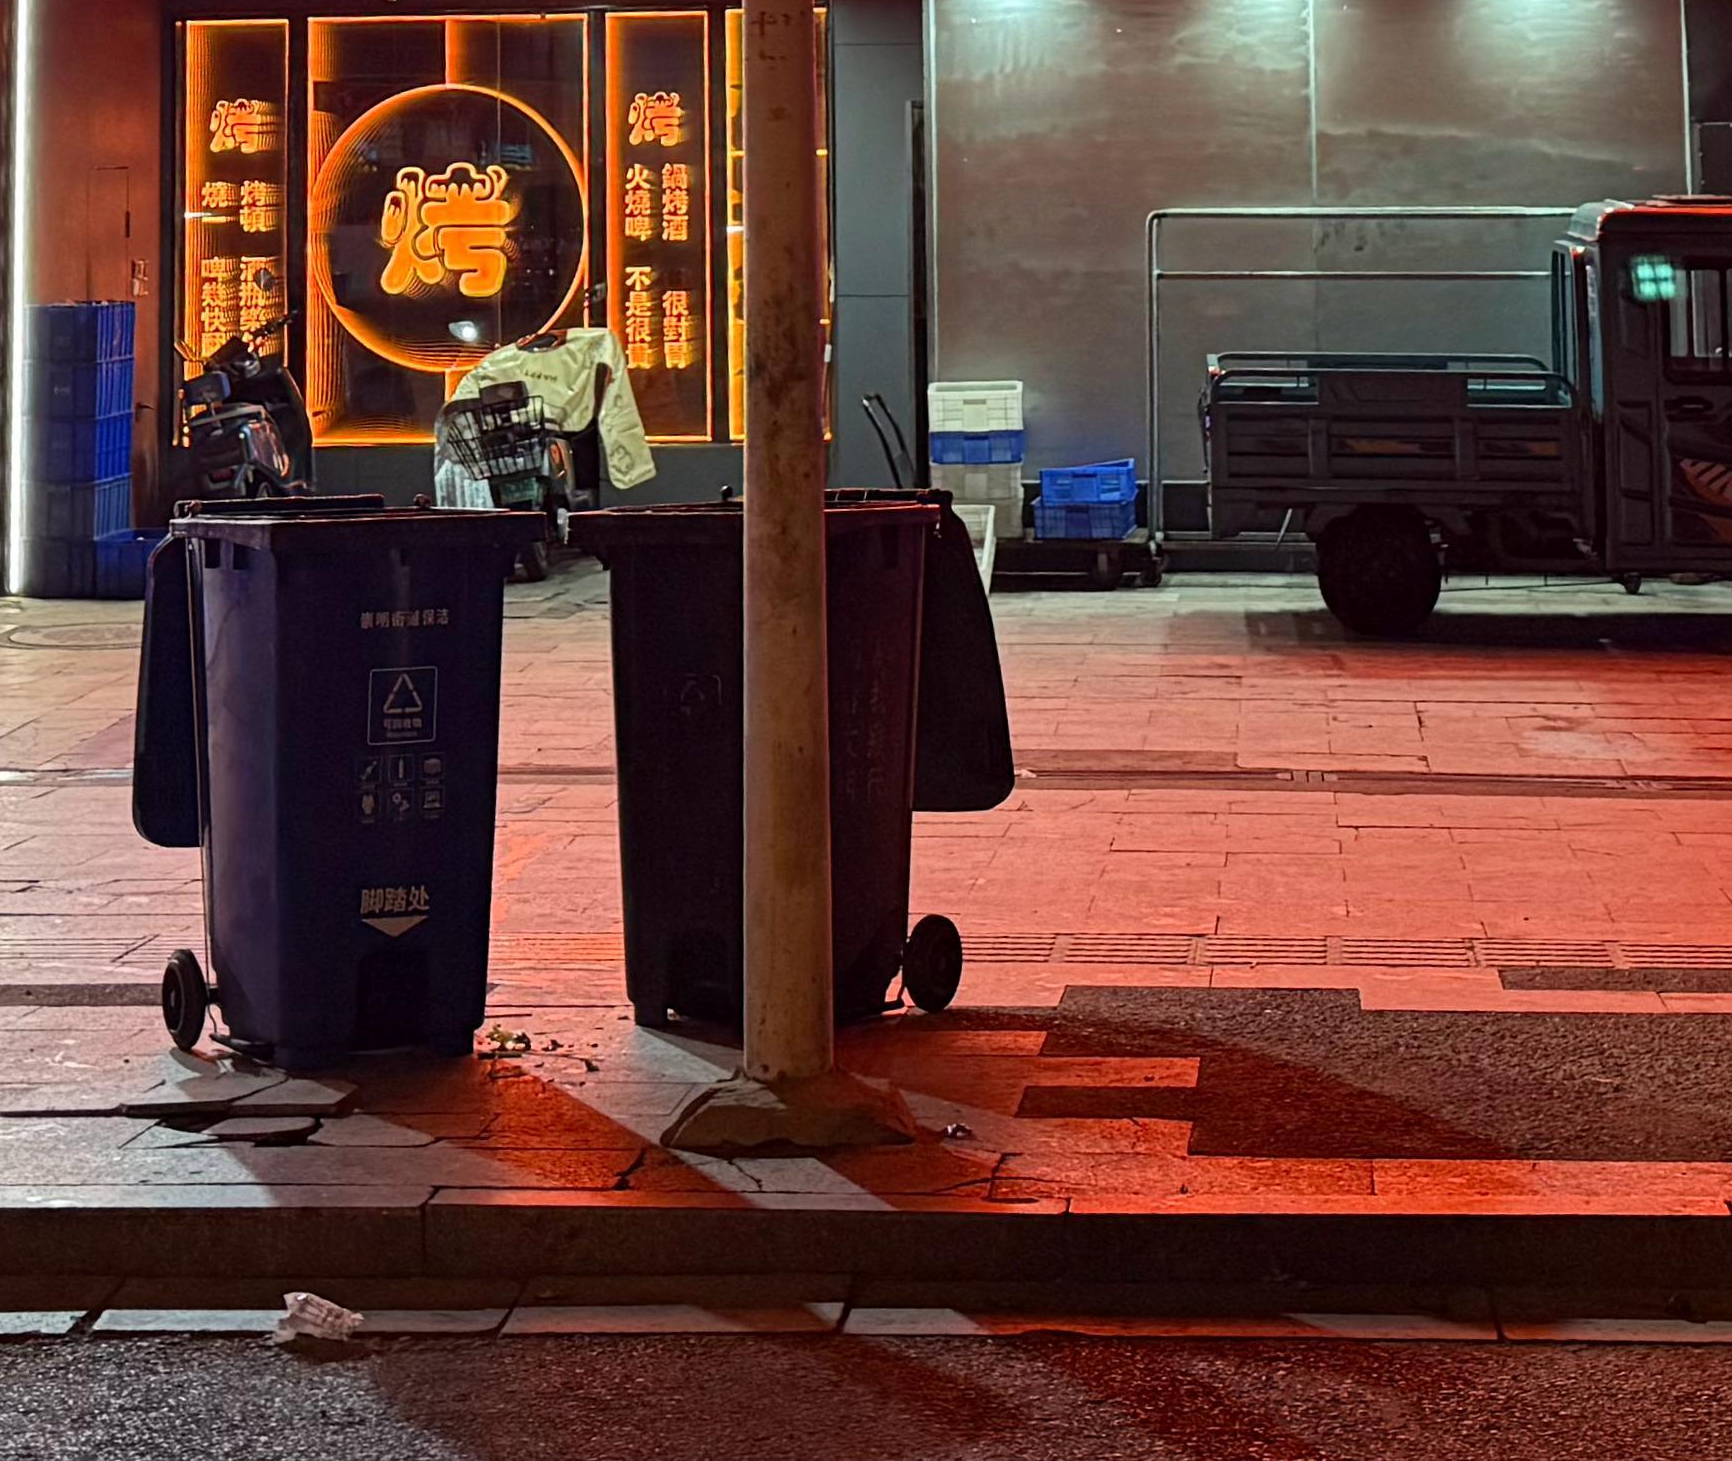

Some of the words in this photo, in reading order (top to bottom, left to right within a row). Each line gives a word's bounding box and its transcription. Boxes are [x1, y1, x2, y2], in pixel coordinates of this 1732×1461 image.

[209, 98, 265, 153] 烤
[627, 91, 681, 147] 烤
[380, 162, 517, 299] 烤
[360, 885, 431, 915] 脚踏处
